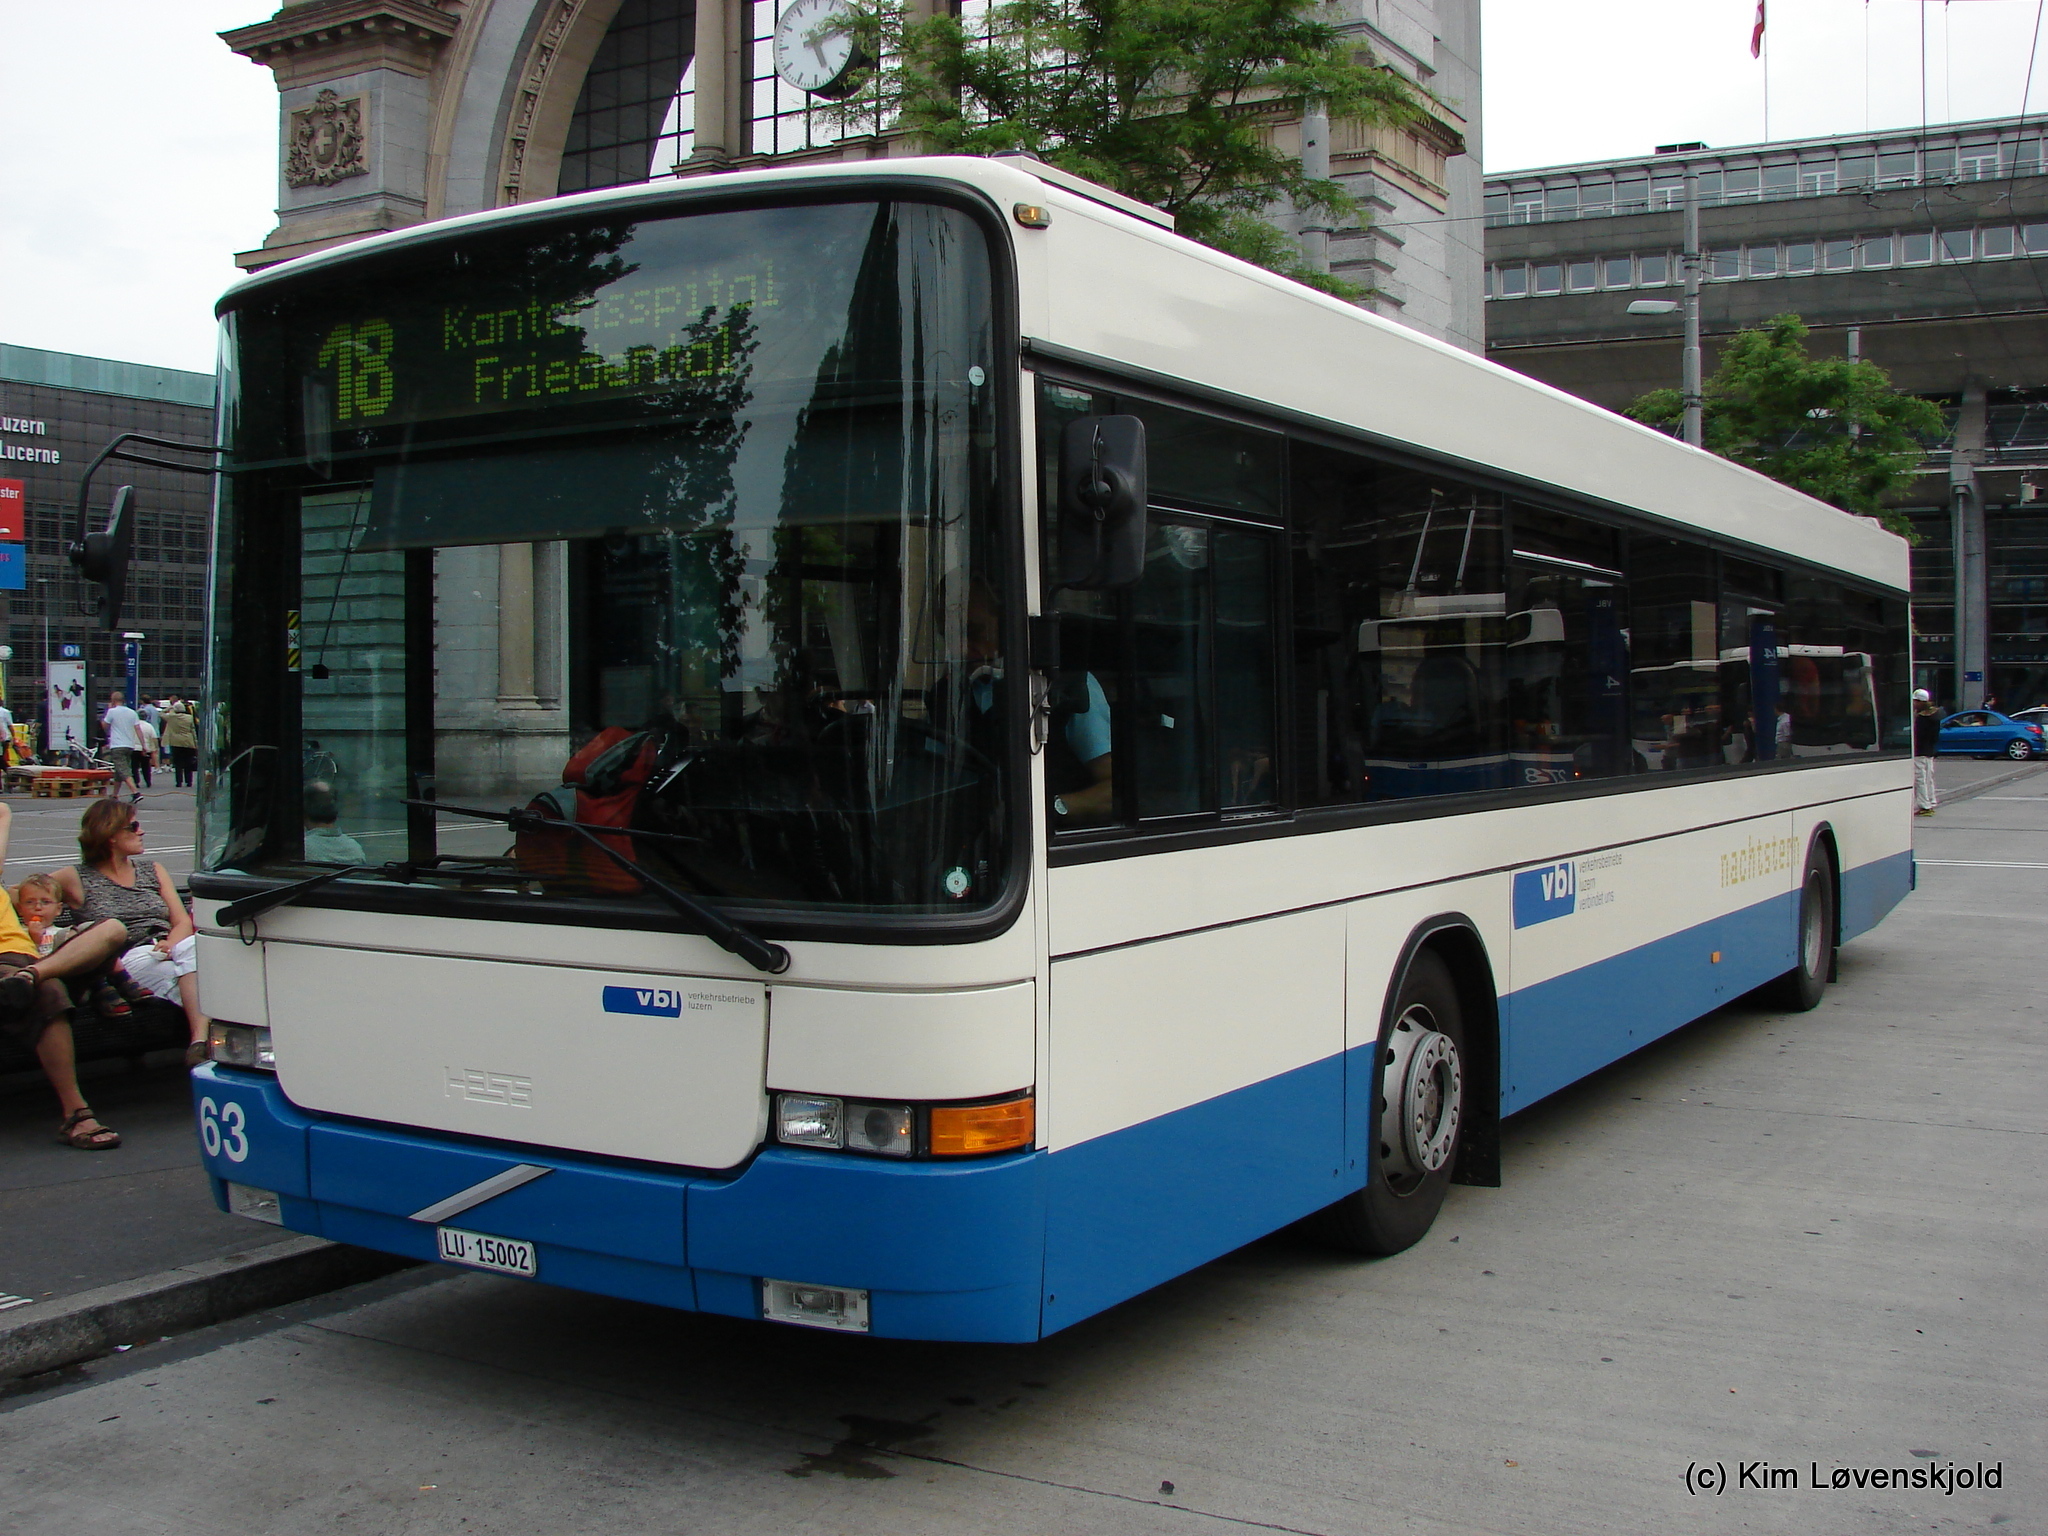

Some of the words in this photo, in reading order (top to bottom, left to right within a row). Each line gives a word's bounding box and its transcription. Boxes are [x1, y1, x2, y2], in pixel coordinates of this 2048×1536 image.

[319, 318, 395, 420] 18
[0, 416, 46, 436] uzern
[0, 440, 61, 465] Lucerne
[1541, 861, 1573, 901] vbl
[636, 989, 678, 1009] vbl
[688, 991, 756, 1005] verkehrsbetriebe
[688, 1001, 713, 1011] luzern
[200, 1096, 249, 1163] 63
